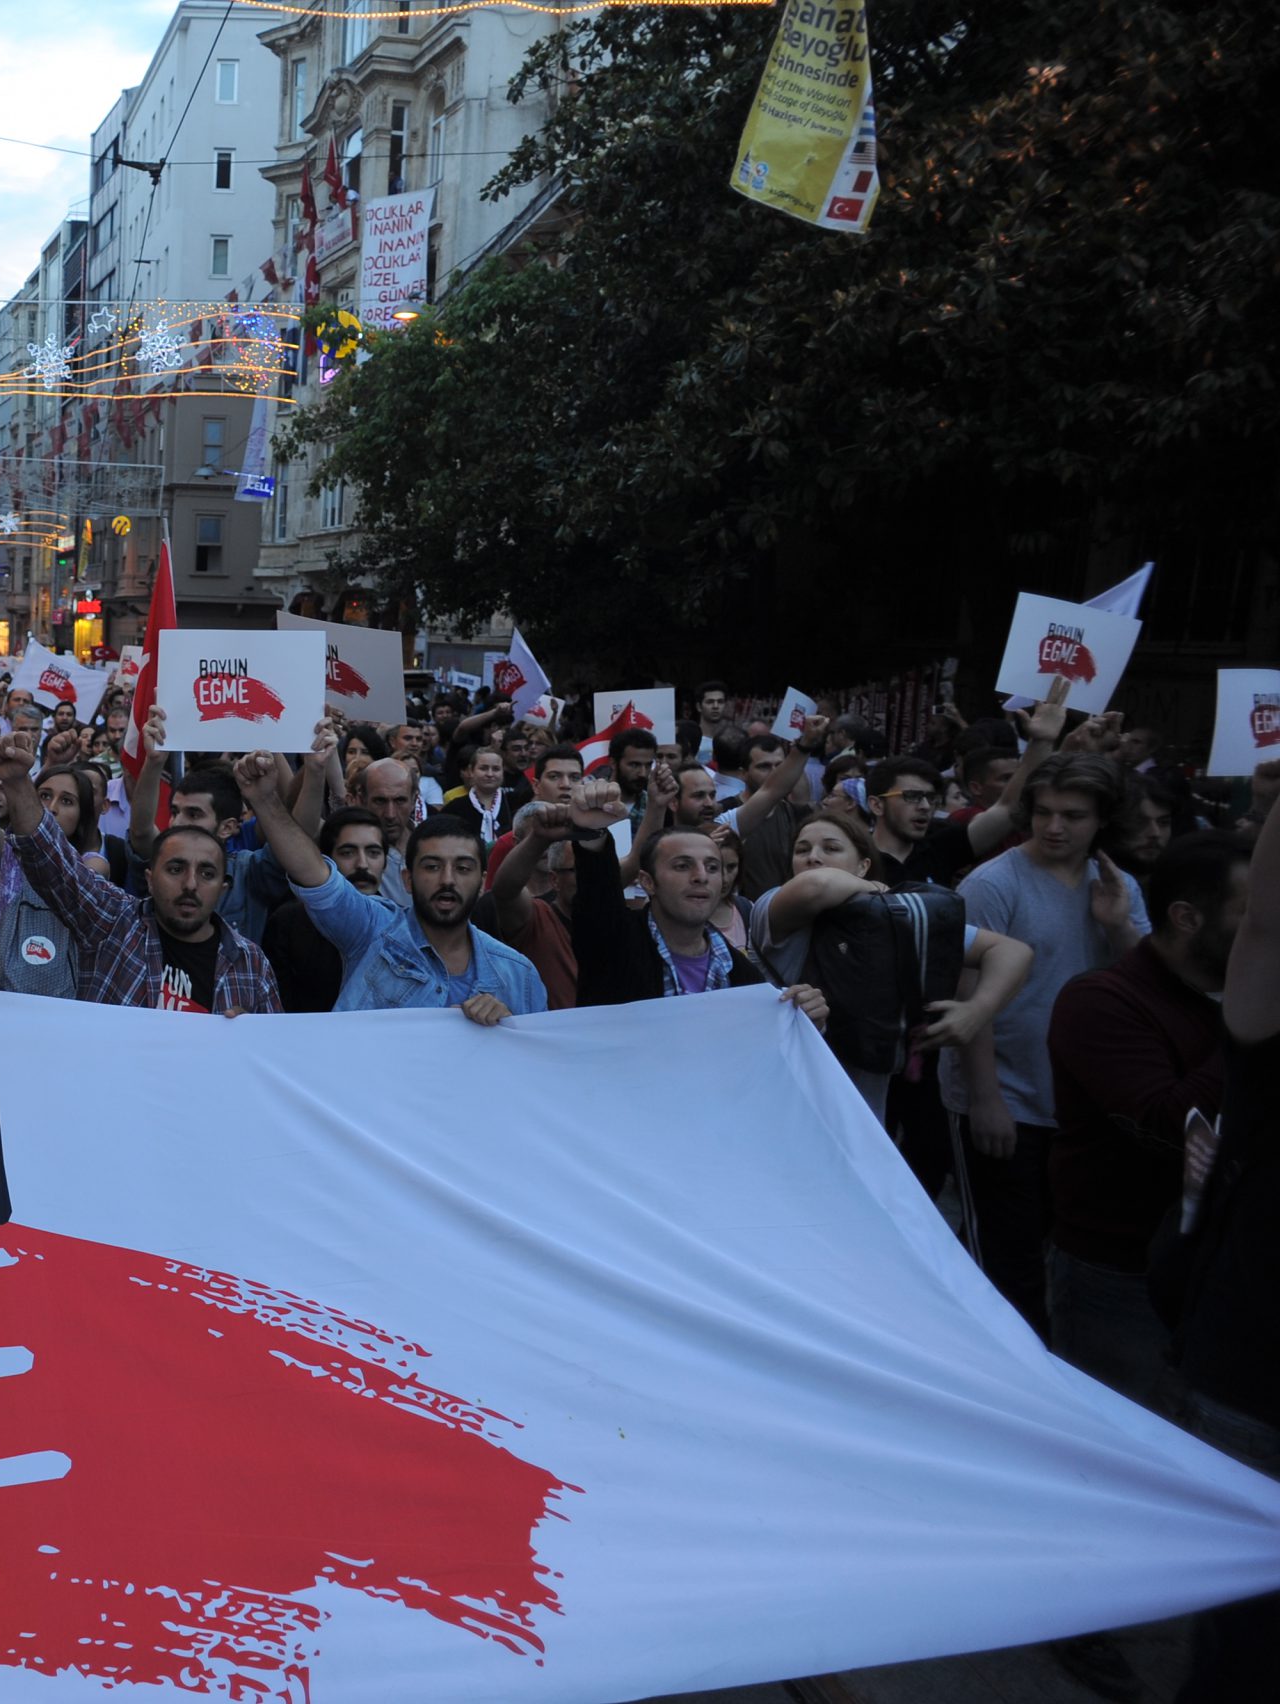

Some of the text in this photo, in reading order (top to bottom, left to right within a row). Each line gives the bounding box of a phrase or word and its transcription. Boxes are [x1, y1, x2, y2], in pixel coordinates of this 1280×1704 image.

[1048, 622, 1085, 644] BOYUN
[199, 658, 248, 679] BOYUN
[199, 678, 250, 706] EĞME
